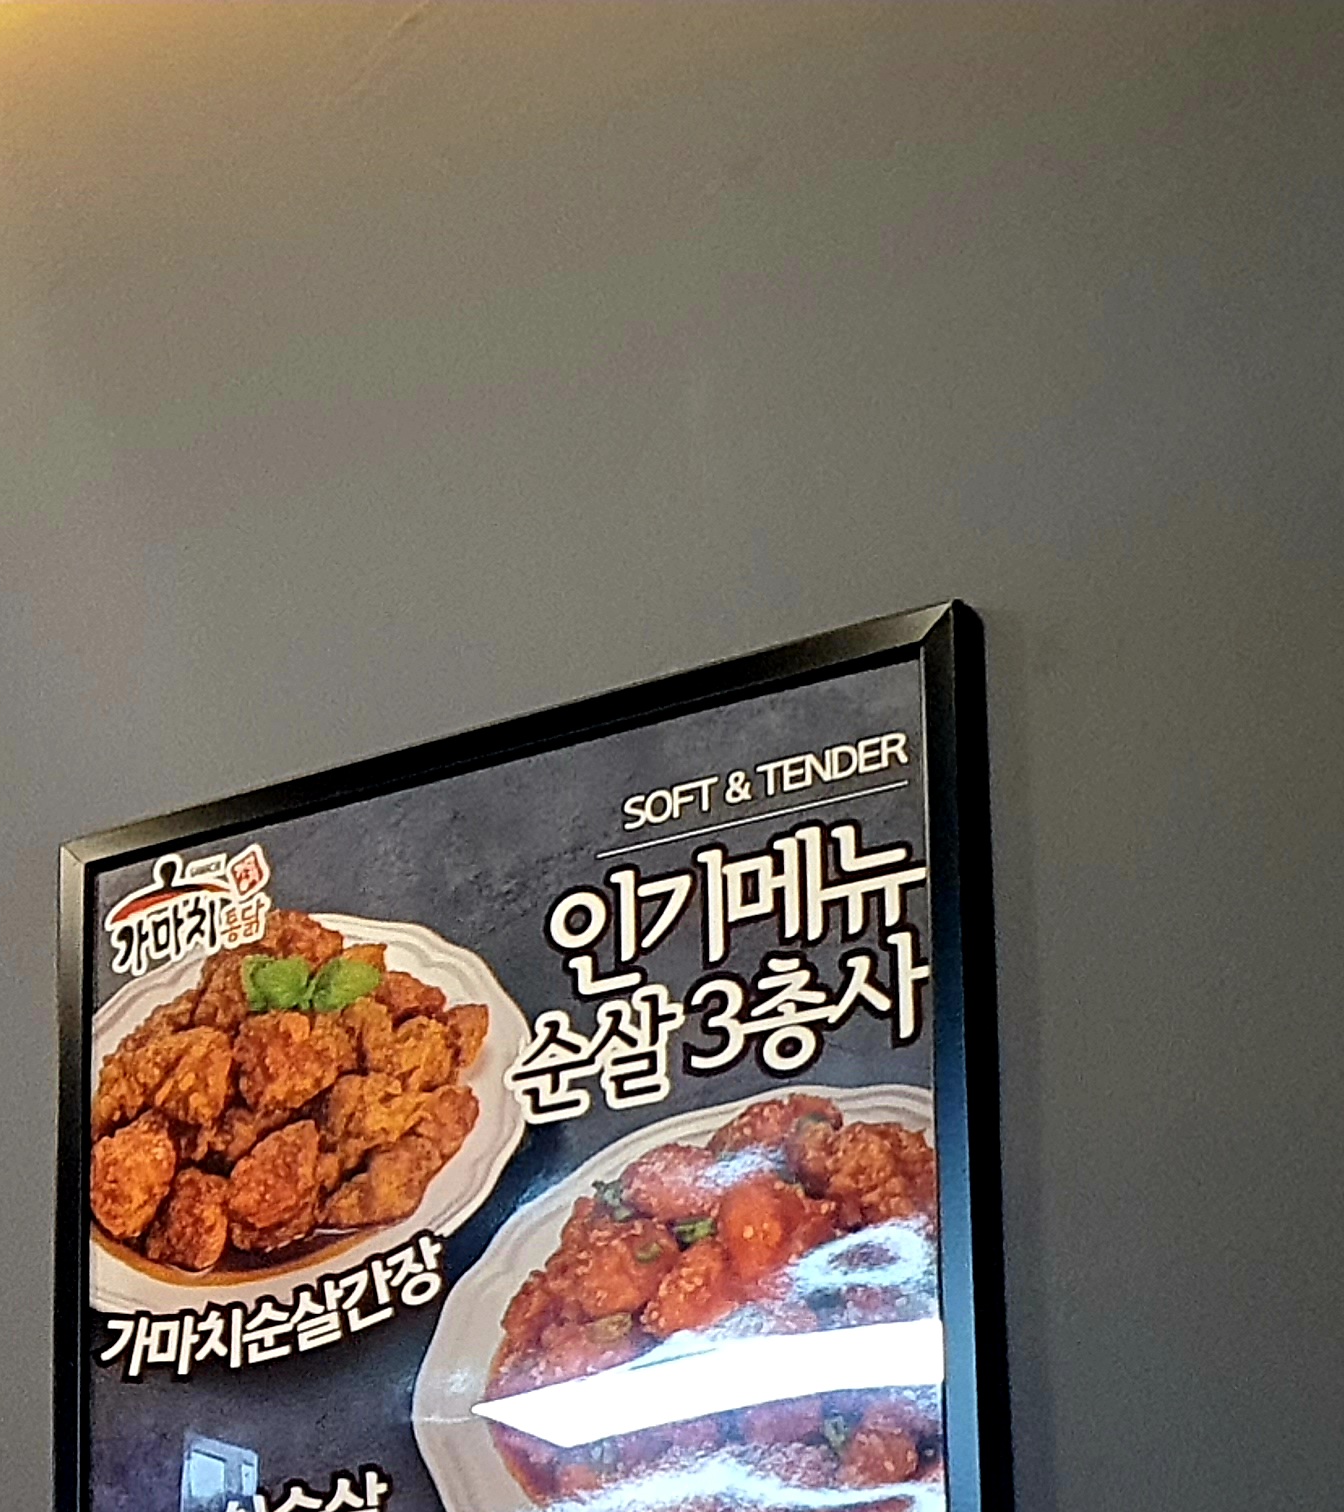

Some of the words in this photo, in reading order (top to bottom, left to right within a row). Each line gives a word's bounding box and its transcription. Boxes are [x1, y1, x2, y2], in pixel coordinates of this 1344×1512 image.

[623, 777, 718, 830] SOFT
[724, 771, 752, 804] &
[756, 732, 909, 796] TENDER
[116, 895, 218, 971] 가마치
[550, 824, 926, 997] 인기메뉴
[508, 987, 682, 1124] 순살
[688, 934, 929, 1073] 3총사
[102, 1238, 443, 1378] 가마치순살간장
